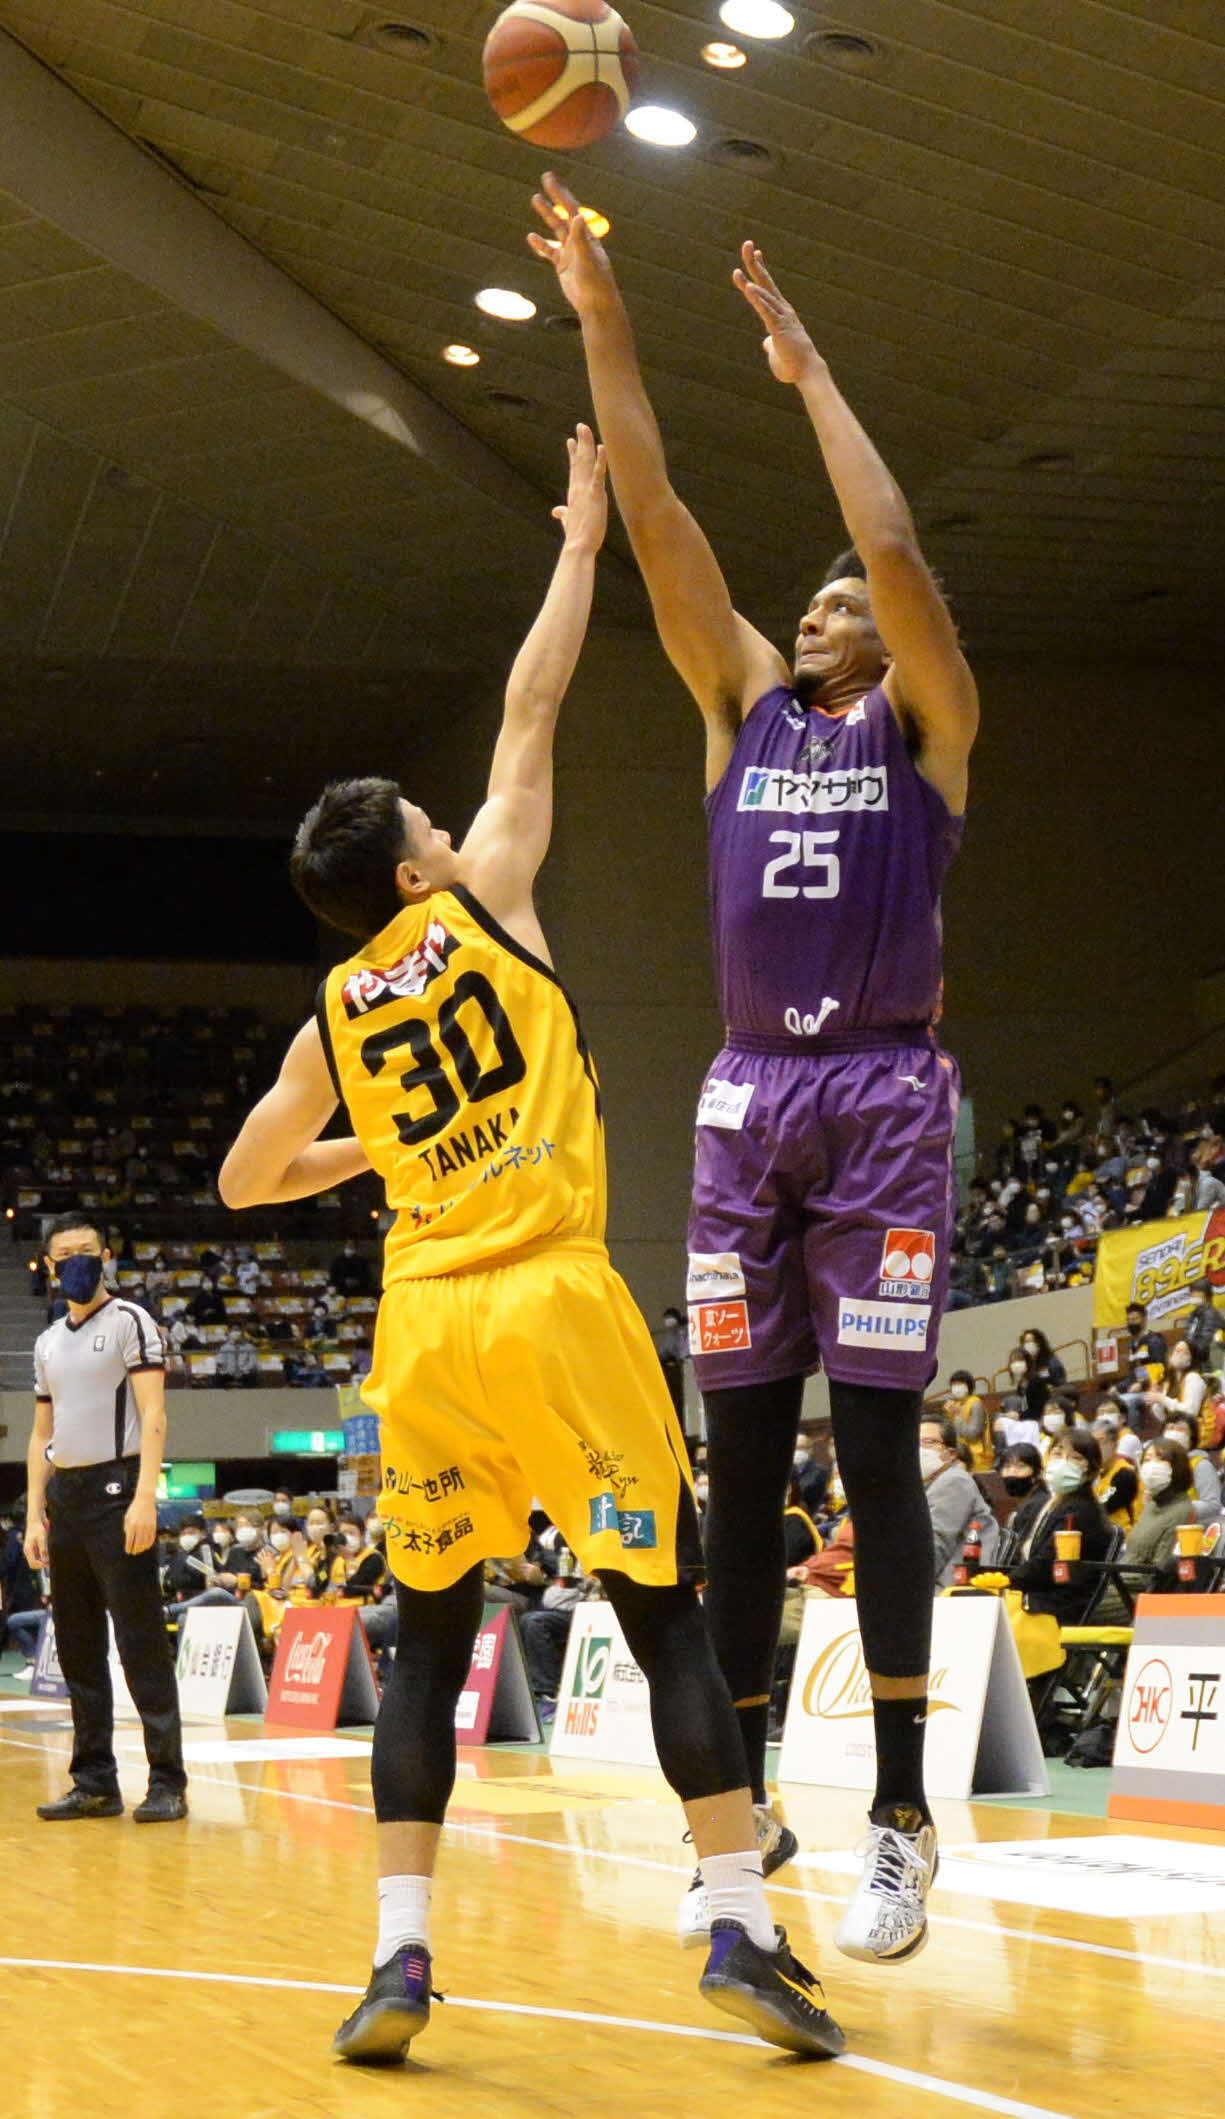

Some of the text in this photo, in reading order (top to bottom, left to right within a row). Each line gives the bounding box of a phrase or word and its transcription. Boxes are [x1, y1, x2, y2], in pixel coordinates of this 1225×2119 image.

[762, 830, 840, 899] 25
[361, 970, 527, 1146] 30
[842, 1312, 927, 1337] PHILIPS
[1180, 1672, 1222, 1752] 平
